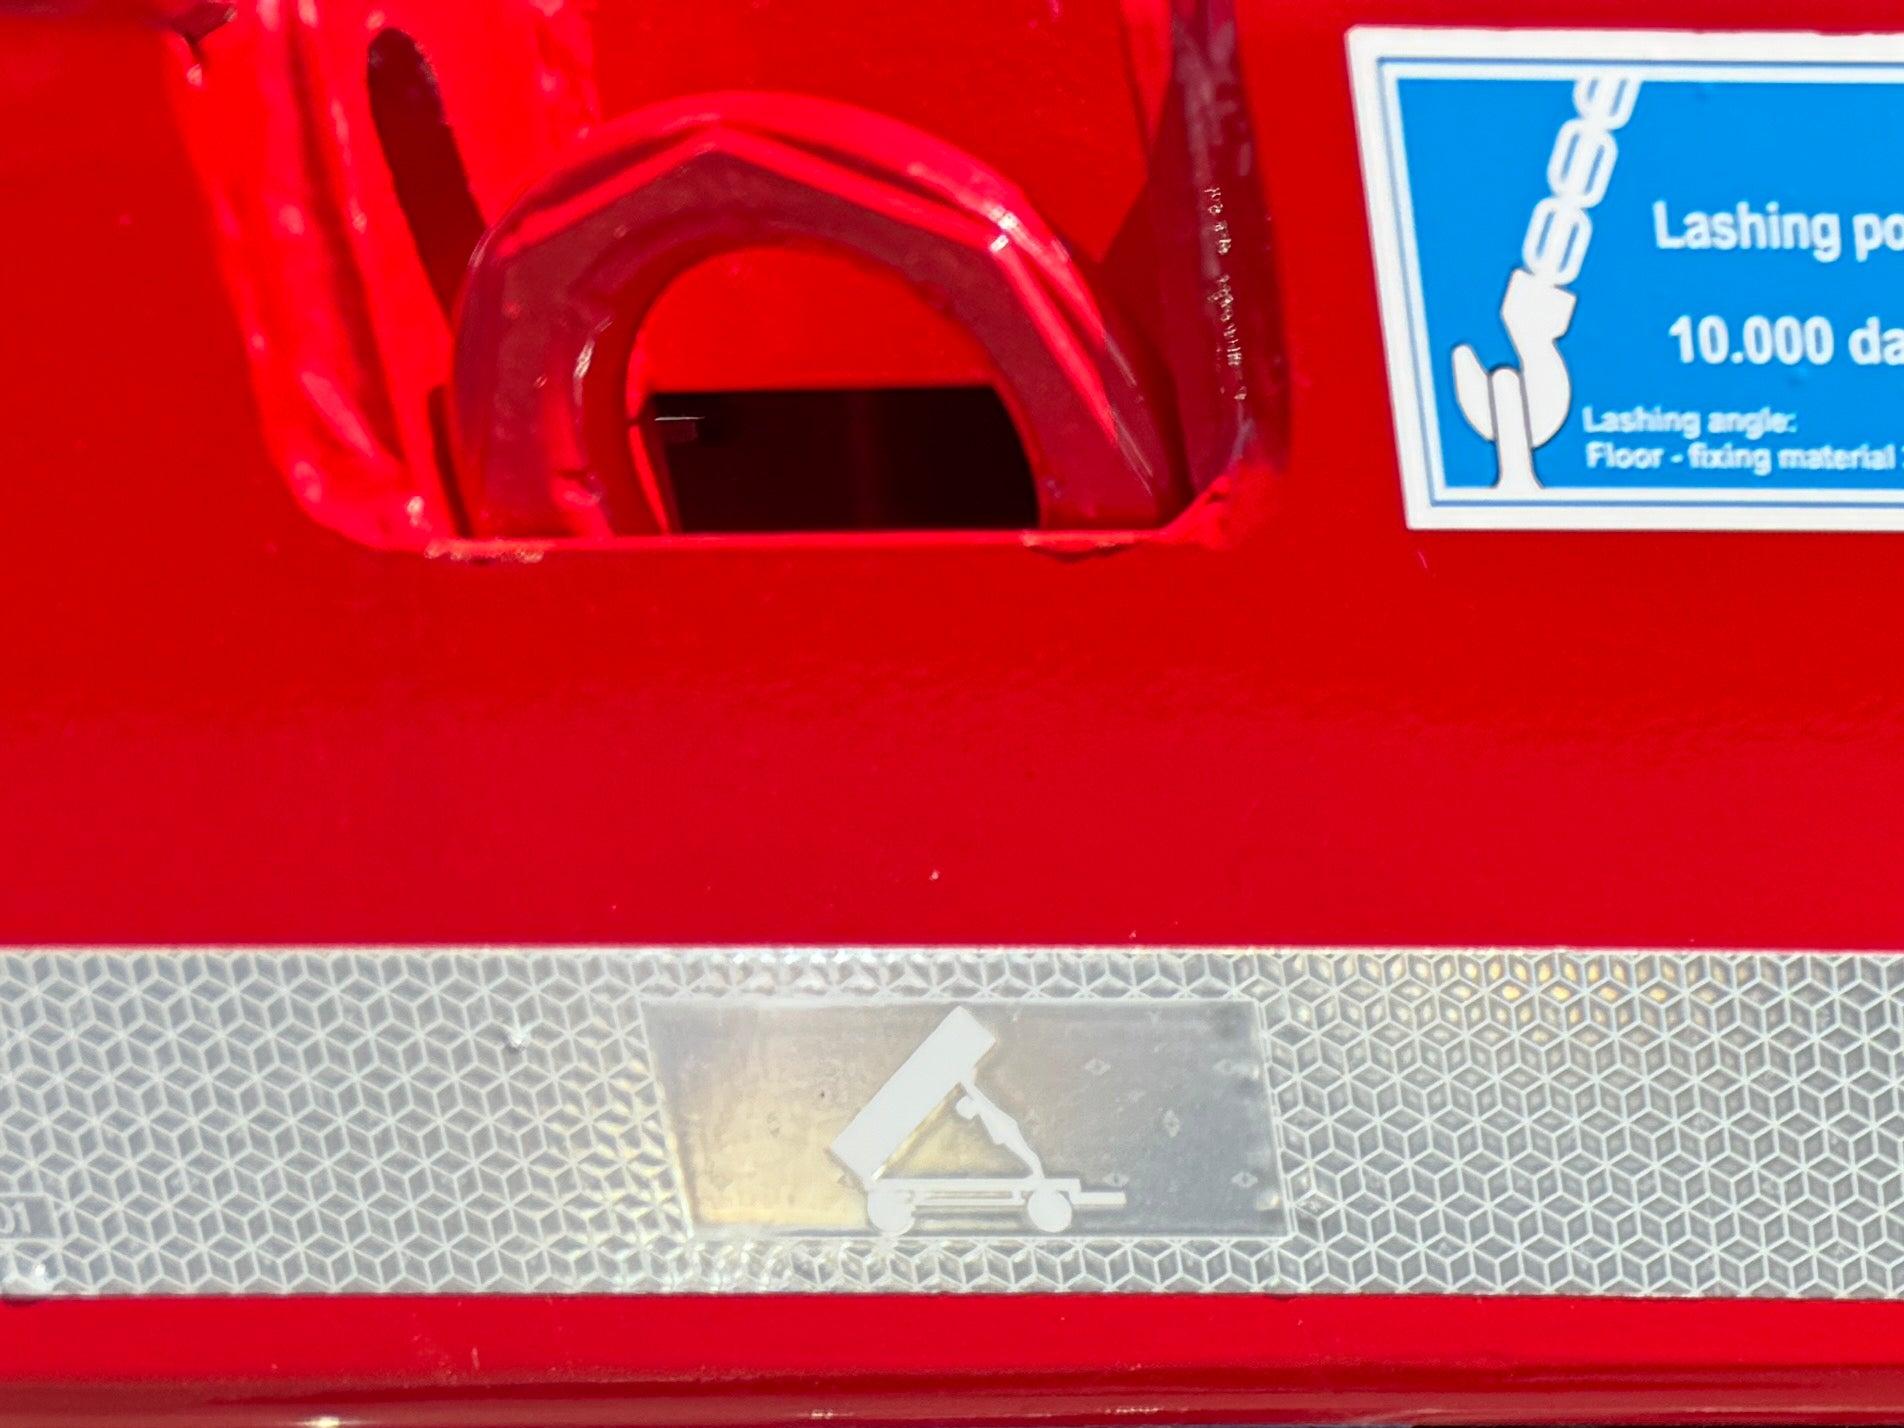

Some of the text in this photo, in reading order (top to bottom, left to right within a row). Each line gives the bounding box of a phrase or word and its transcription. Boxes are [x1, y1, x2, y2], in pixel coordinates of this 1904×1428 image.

[1652, 201, 1841, 262] Lashing
[1669, 316, 1834, 366] 10.000
[1582, 405, 1798, 439] Lashing angle:
[1586, 440, 1664, 470] Floor
[1687, 441, 1772, 476] fixing
[1778, 443, 1896, 472] material
